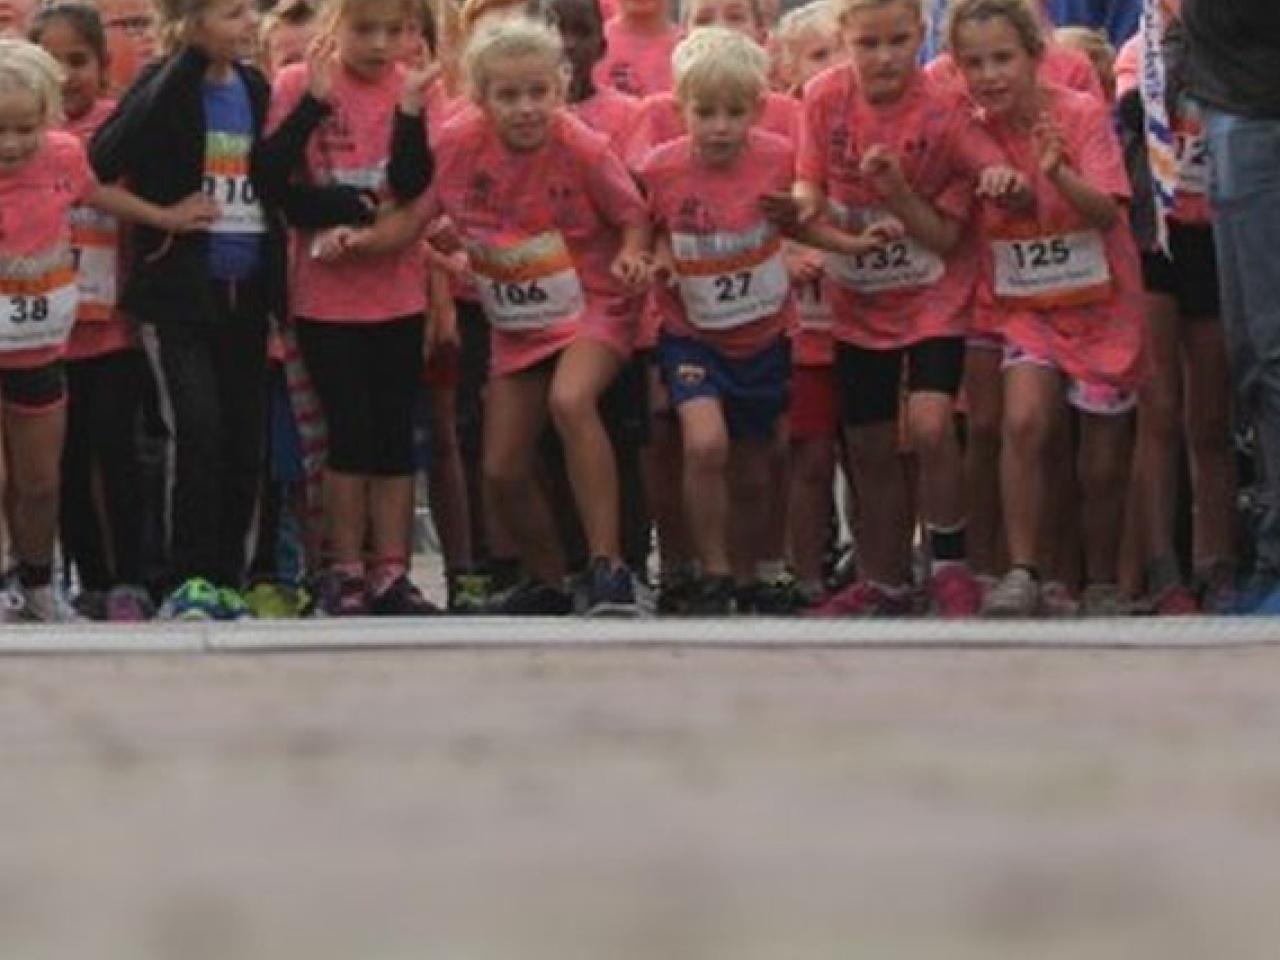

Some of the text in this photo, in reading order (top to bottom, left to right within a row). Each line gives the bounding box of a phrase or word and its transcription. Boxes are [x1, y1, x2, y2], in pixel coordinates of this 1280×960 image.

[1011, 239, 1070, 269] 125
[714, 271, 754, 302] 27
[9, 296, 49, 324] 38
